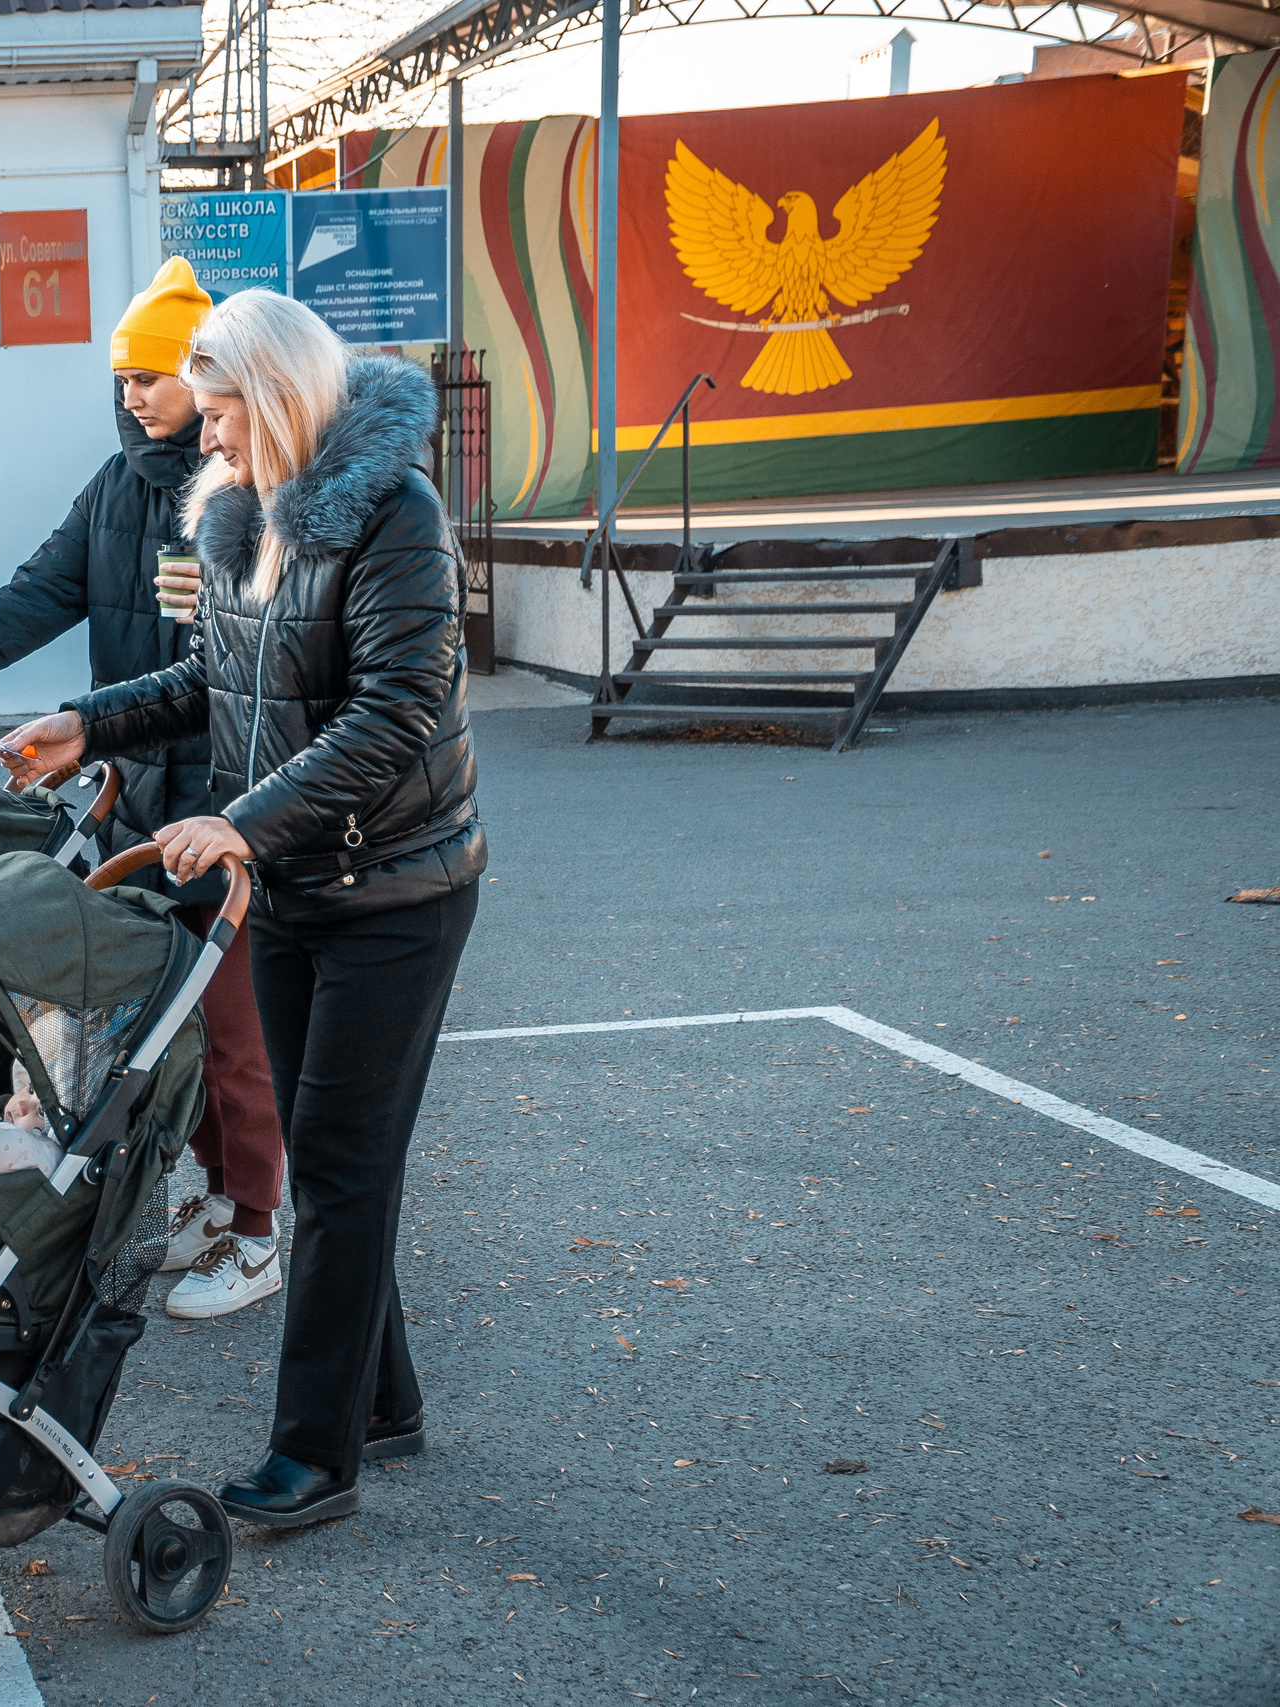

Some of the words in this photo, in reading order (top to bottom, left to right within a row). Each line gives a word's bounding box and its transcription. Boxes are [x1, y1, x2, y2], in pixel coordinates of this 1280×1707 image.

[215, 200, 277, 216] ШКОЛА
[368, 206, 417, 216] ФЕДЕРАЛЬНЫЙ
[161, 223, 250, 240] ИСКУССТВ
[316, 226, 355, 234] НАЦИОНАЛЬНЫЕ
[0, 242, 18, 271] ул.
[169, 247, 241, 261] станицы
[345, 268, 394, 278] ОСНАЩЕНИЕ
[23, 268, 61, 318] 61
[315, 283, 335, 294] ДШИ
[335, 283, 347, 292] СТ.
[348, 279, 424, 291] НОВОТИТАРОВСКОЙ
[300, 297, 368, 307] МУЗЫКАЛЬНЫМИ
[369, 292, 439, 303] ИНСТРУМЕНТАМИ,
[323, 308, 359, 320] УЧЕБНОЙ
[360, 305, 416, 317] ЛИТЕРАТУРОЙ,
[336, 320, 404, 332] ОБОРУДОВАНИЕМ
